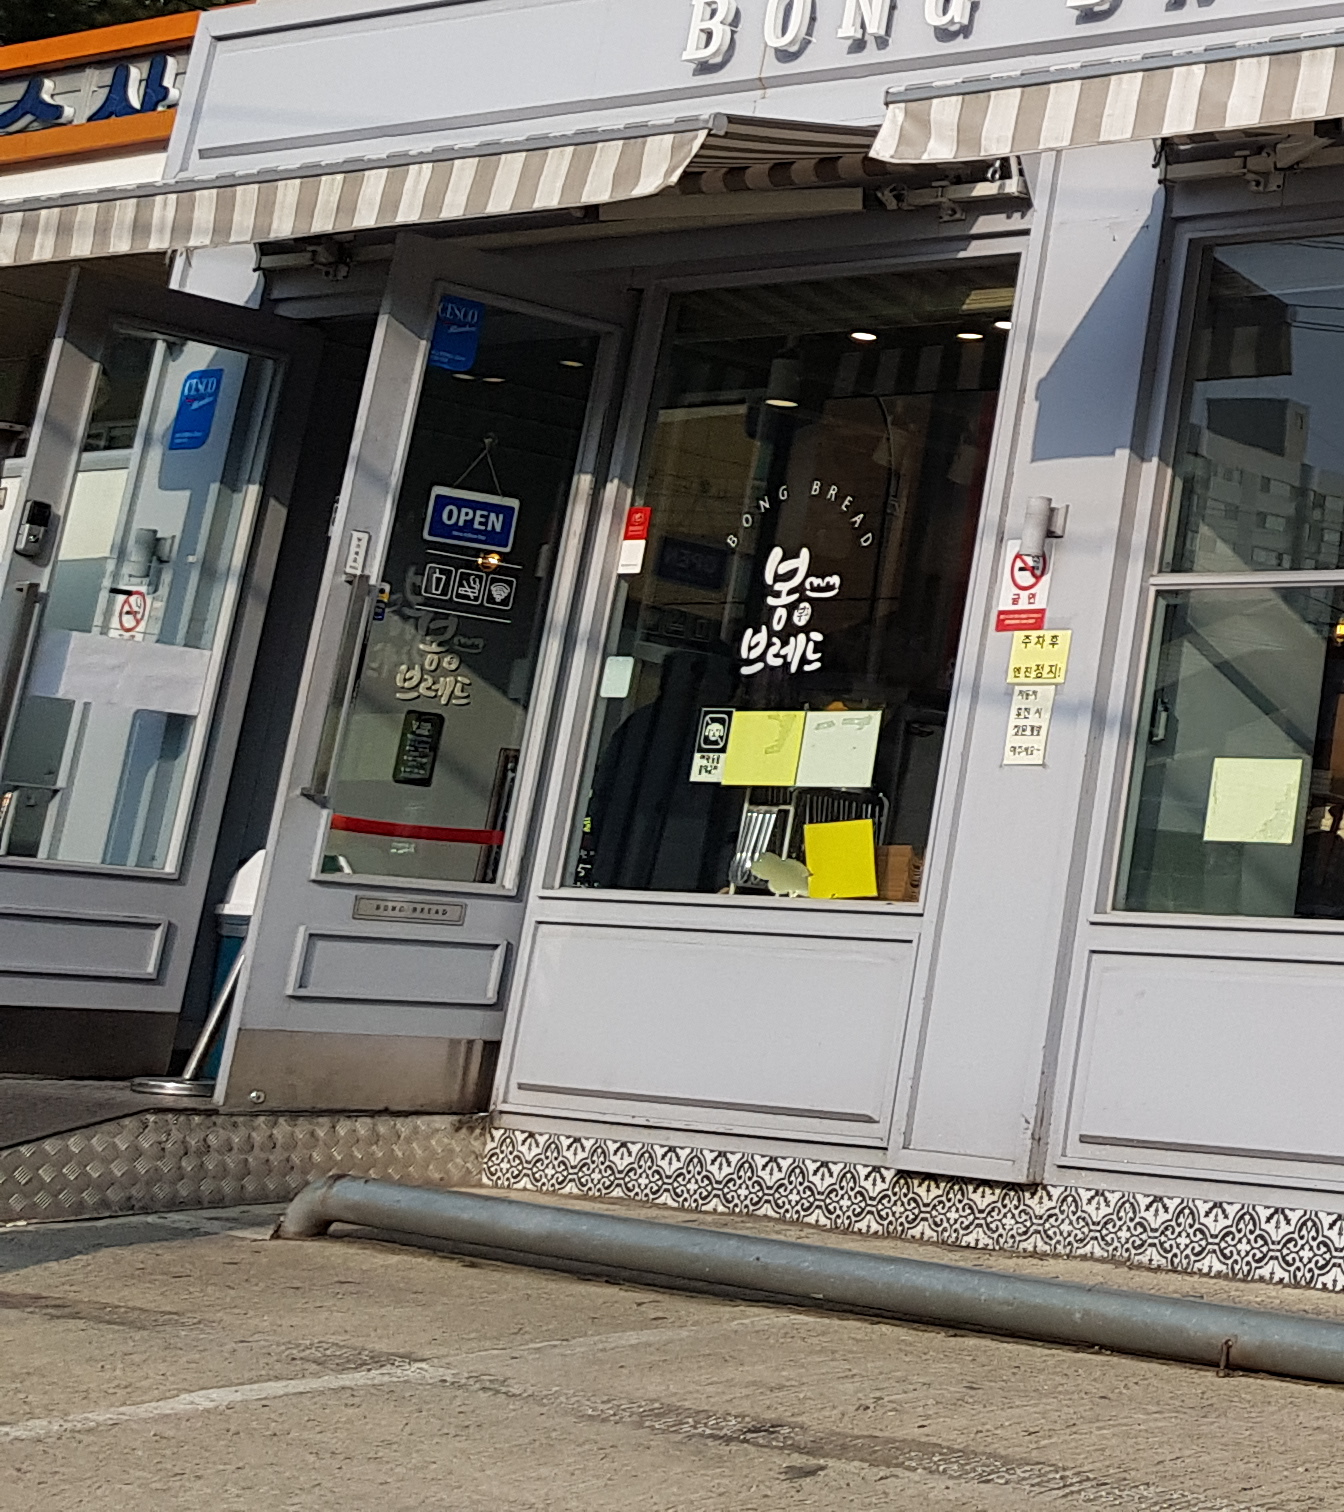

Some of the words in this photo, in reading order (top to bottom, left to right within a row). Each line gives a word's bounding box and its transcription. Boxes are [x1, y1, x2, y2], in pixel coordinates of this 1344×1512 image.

[442, 504, 504, 533] OPEN
[727, 485, 788, 548] BONG
[811, 480, 873, 547] BREAD
[764, 546, 810, 631] 봉
[740, 624, 824, 675] 브레드
[395, 664, 471, 705] 브레드
